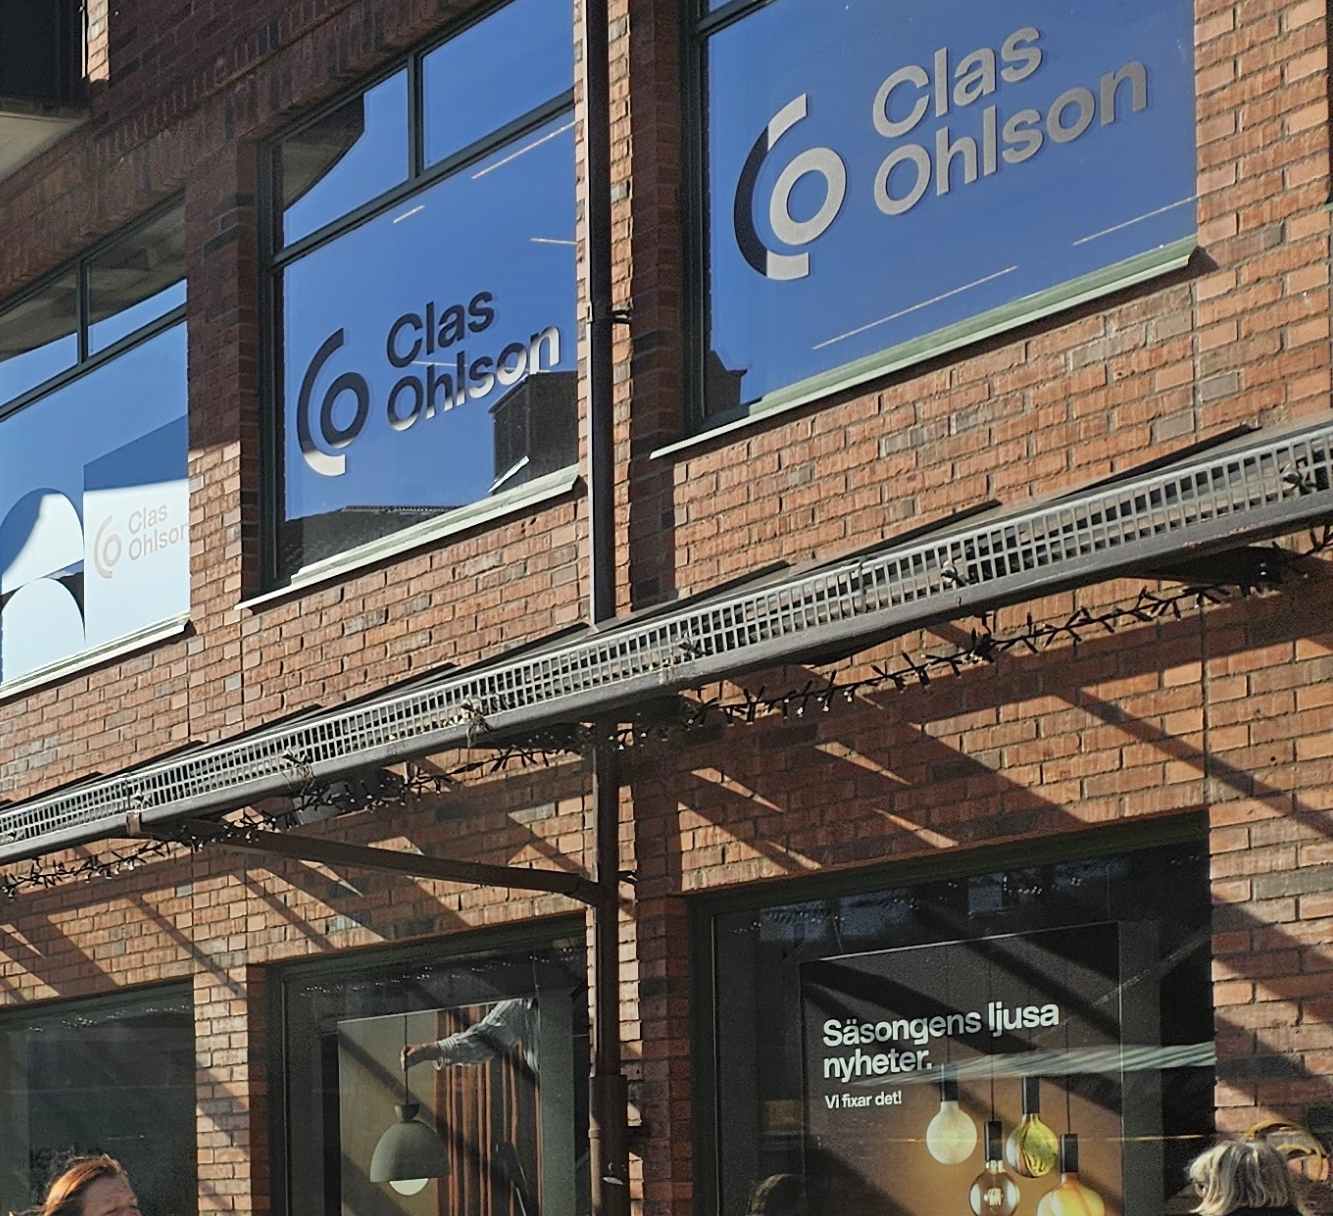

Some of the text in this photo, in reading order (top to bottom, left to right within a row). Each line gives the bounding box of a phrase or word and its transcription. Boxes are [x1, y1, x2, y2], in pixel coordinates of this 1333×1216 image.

[872, 26, 1043, 138] Clas
[873, 60, 1148, 216] Ohlson
[386, 290, 497, 368] Clas
[386, 325, 561, 432] Ohlson
[128, 505, 168, 535] Clas
[823, 1001, 1060, 1046] Säsongens ljusa
[823, 1048, 933, 1083] nyheter.
[825, 1090, 902, 1109] Vi fixar det!
